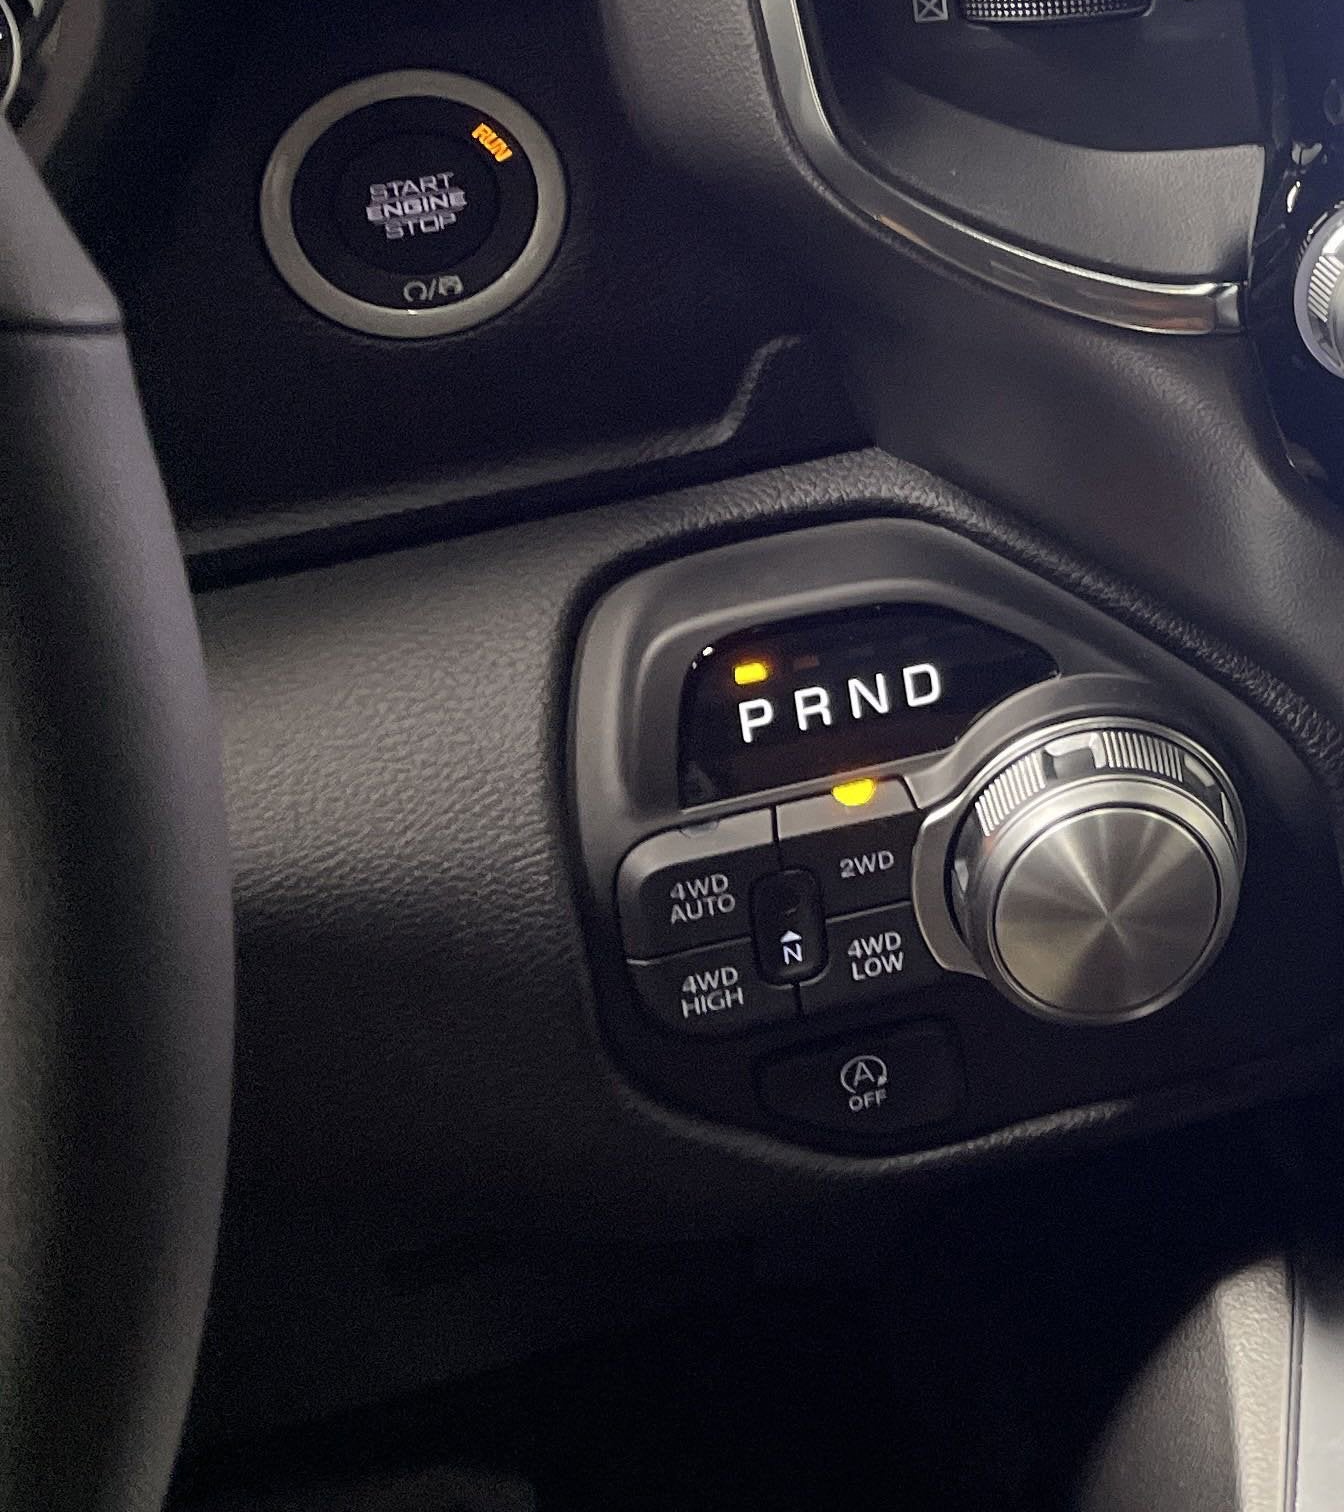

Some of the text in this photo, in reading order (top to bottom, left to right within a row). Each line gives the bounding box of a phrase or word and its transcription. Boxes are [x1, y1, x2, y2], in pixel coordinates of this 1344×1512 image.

[471, 122, 513, 163] RUN
[369, 171, 455, 202] START
[365, 188, 467, 223] ENGINE
[385, 212, 457, 240] STOP
[839, 849, 895, 879] 2WD
[669, 873, 729, 901] 4WD
[669, 892, 736, 925] AUTO
[782, 941, 803, 965] N
[847, 929, 902, 962] 4WD
[682, 965, 738, 996] 4WD
[850, 949, 905, 982] LOW
[680, 986, 744, 1019] HIGH
[848, 1091, 888, 1113] OFF
